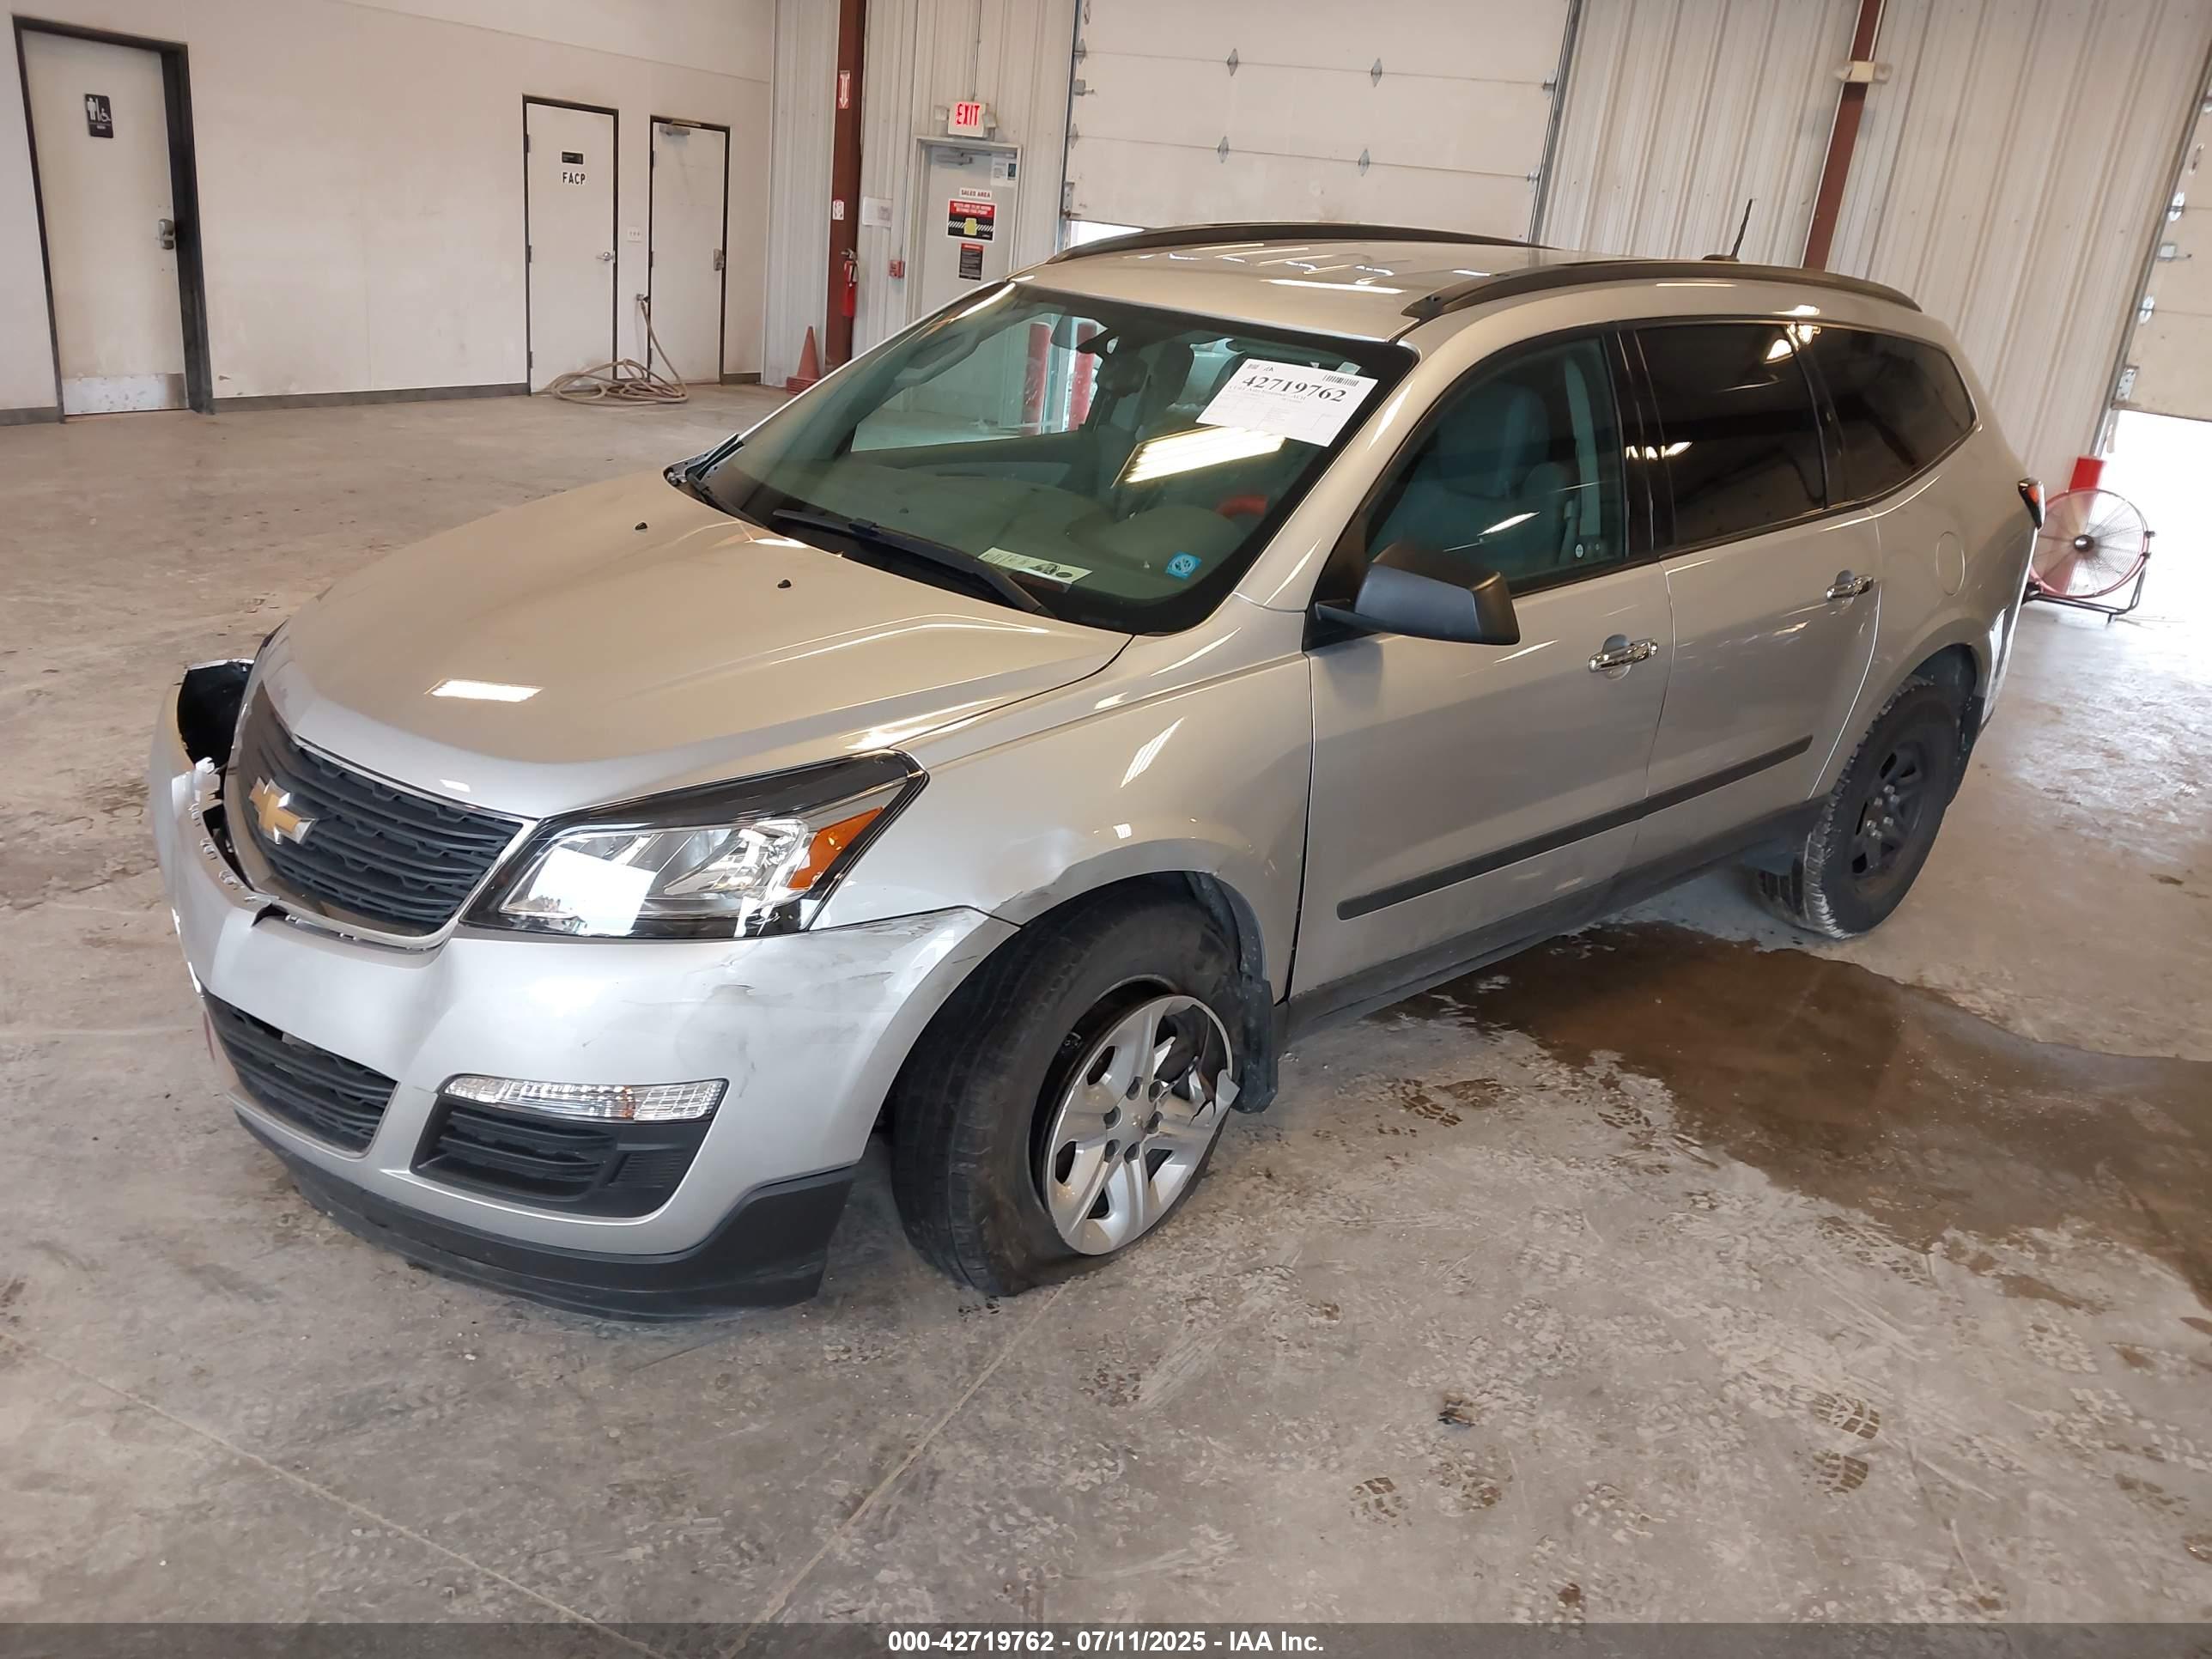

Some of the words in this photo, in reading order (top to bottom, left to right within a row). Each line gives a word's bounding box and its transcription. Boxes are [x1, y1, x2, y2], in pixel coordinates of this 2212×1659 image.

[956, 103, 981, 126] EXIT
[562, 172, 586, 185] FACP
[1242, 375, 1347, 402] 42719762
